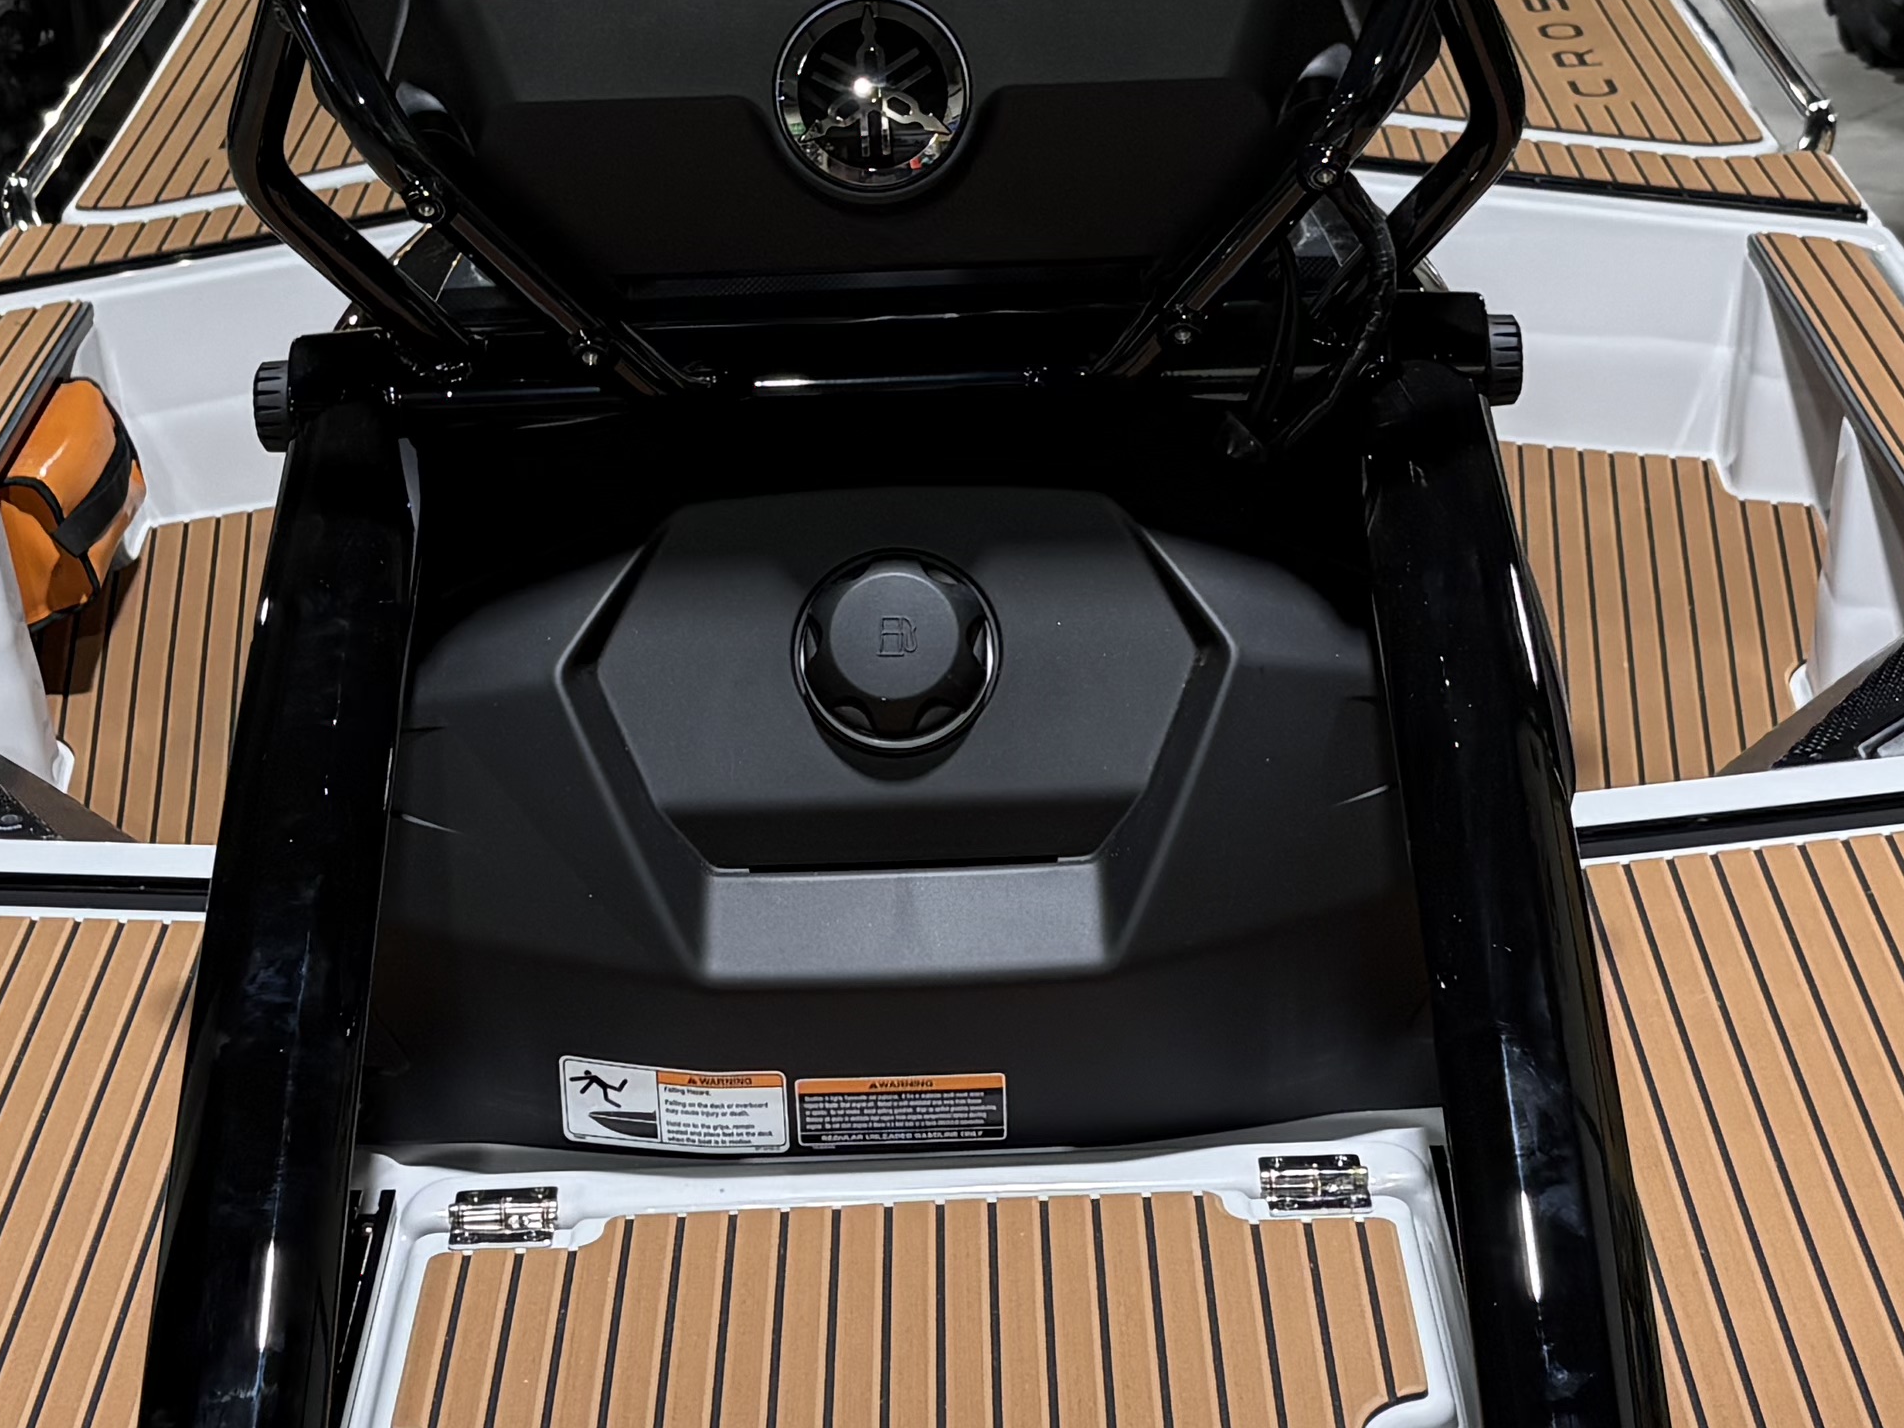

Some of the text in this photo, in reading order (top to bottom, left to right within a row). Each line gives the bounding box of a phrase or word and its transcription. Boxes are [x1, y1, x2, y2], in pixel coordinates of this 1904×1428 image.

[699, 1077, 753, 1086] WARNING
[878, 1079, 934, 1088] WARNING
[664, 1086, 686, 1096] Falling
[664, 1099, 687, 1109] Falling
[697, 1101, 708, 1109] the
[735, 1101, 769, 1109] overboard
[665, 1108, 679, 1116] may
[701, 1109, 719, 1118] injury
